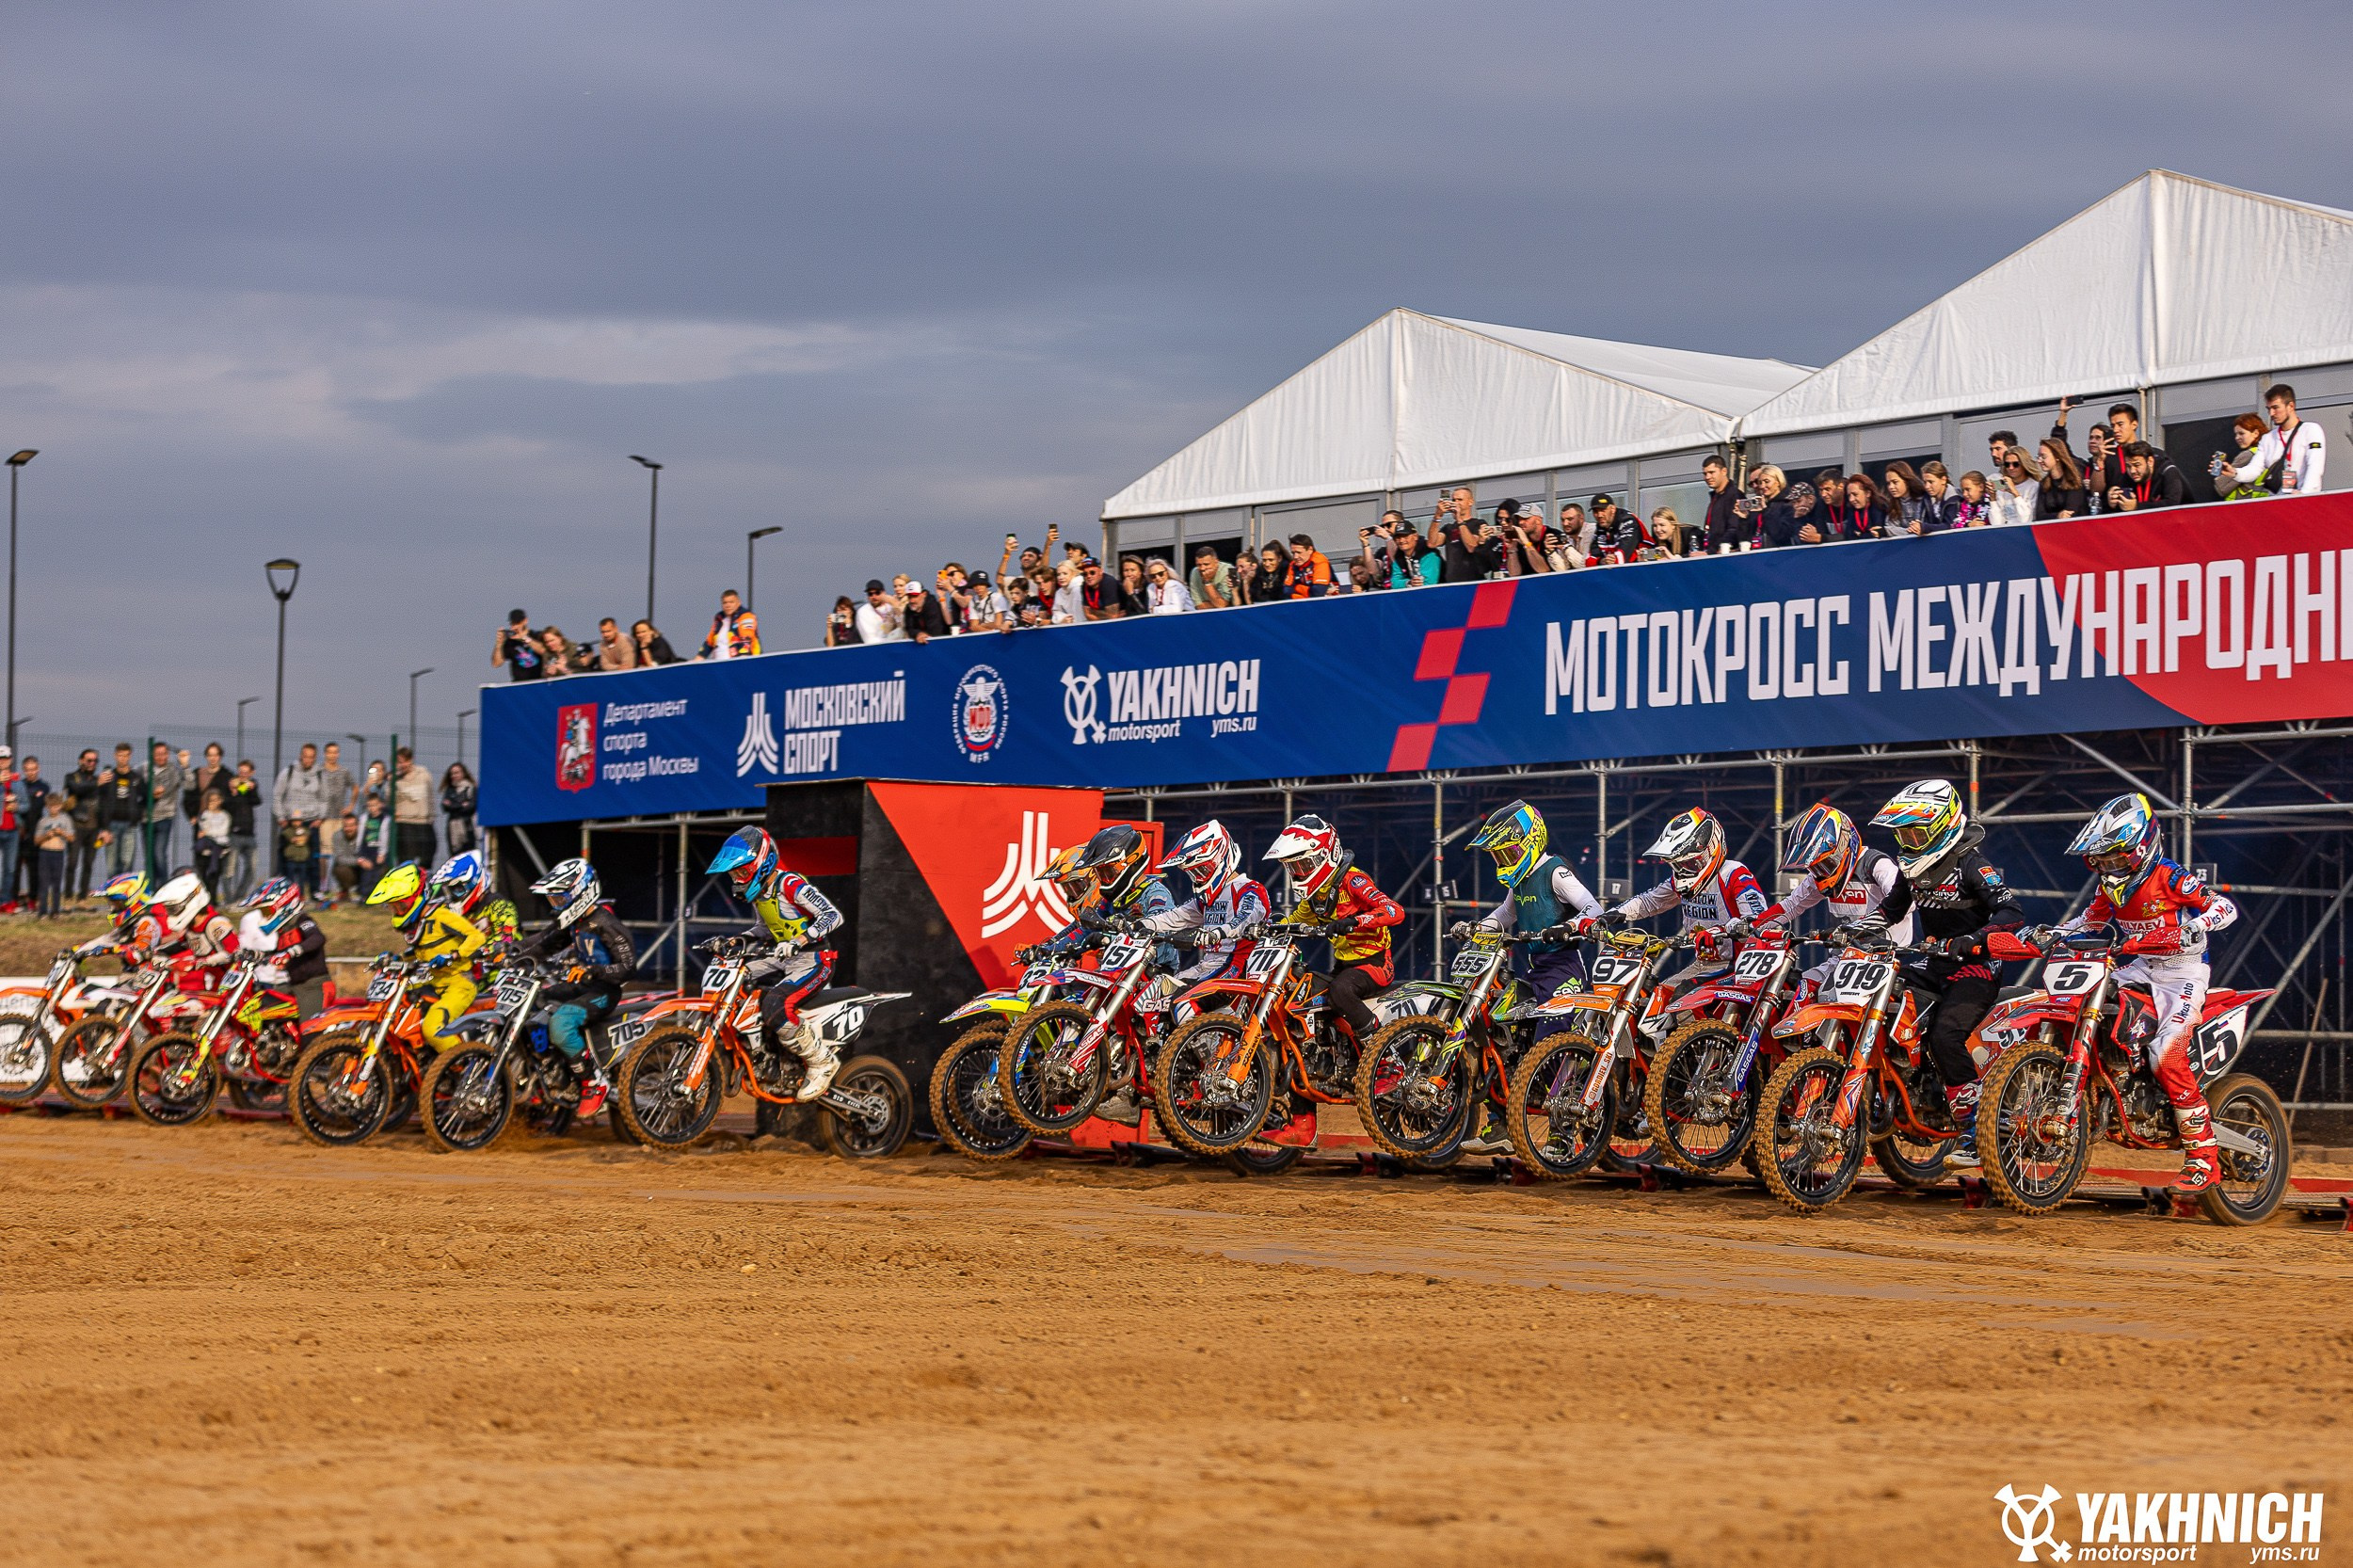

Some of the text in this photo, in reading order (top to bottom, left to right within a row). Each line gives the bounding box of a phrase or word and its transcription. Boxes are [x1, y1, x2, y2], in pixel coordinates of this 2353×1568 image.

[1545, 594, 1850, 716] МОТОКРОСС
[785, 670, 906, 730] МОСКОВСКИЙ
[1107, 659, 1261, 724] YAKHNICH
[603, 698, 688, 728] Департамент
[603, 731, 648, 756] спорта
[1107, 716, 1257, 744] motorsport yms.ru
[784, 729, 841, 776] СПОРТ
[602, 755, 699, 785] города Москвы
[1683, 905, 1718, 920] REGION
[1102, 945, 1139, 968] 151
[1247, 949, 1281, 972] 711
[1737, 952, 1778, 975] 278
[704, 968, 730, 987] 70
[1593, 958, 1640, 983] 97
[1835, 962, 1887, 989] 919
[2053, 964, 2092, 991] 5
[1718, 992, 1753, 1002] GASGAS
[610, 1022, 646, 1046] 705
[832, 1005, 865, 1041] 70
[1737, 1040, 1758, 1082] GASGAS
[2200, 1022, 2238, 1075] 5
